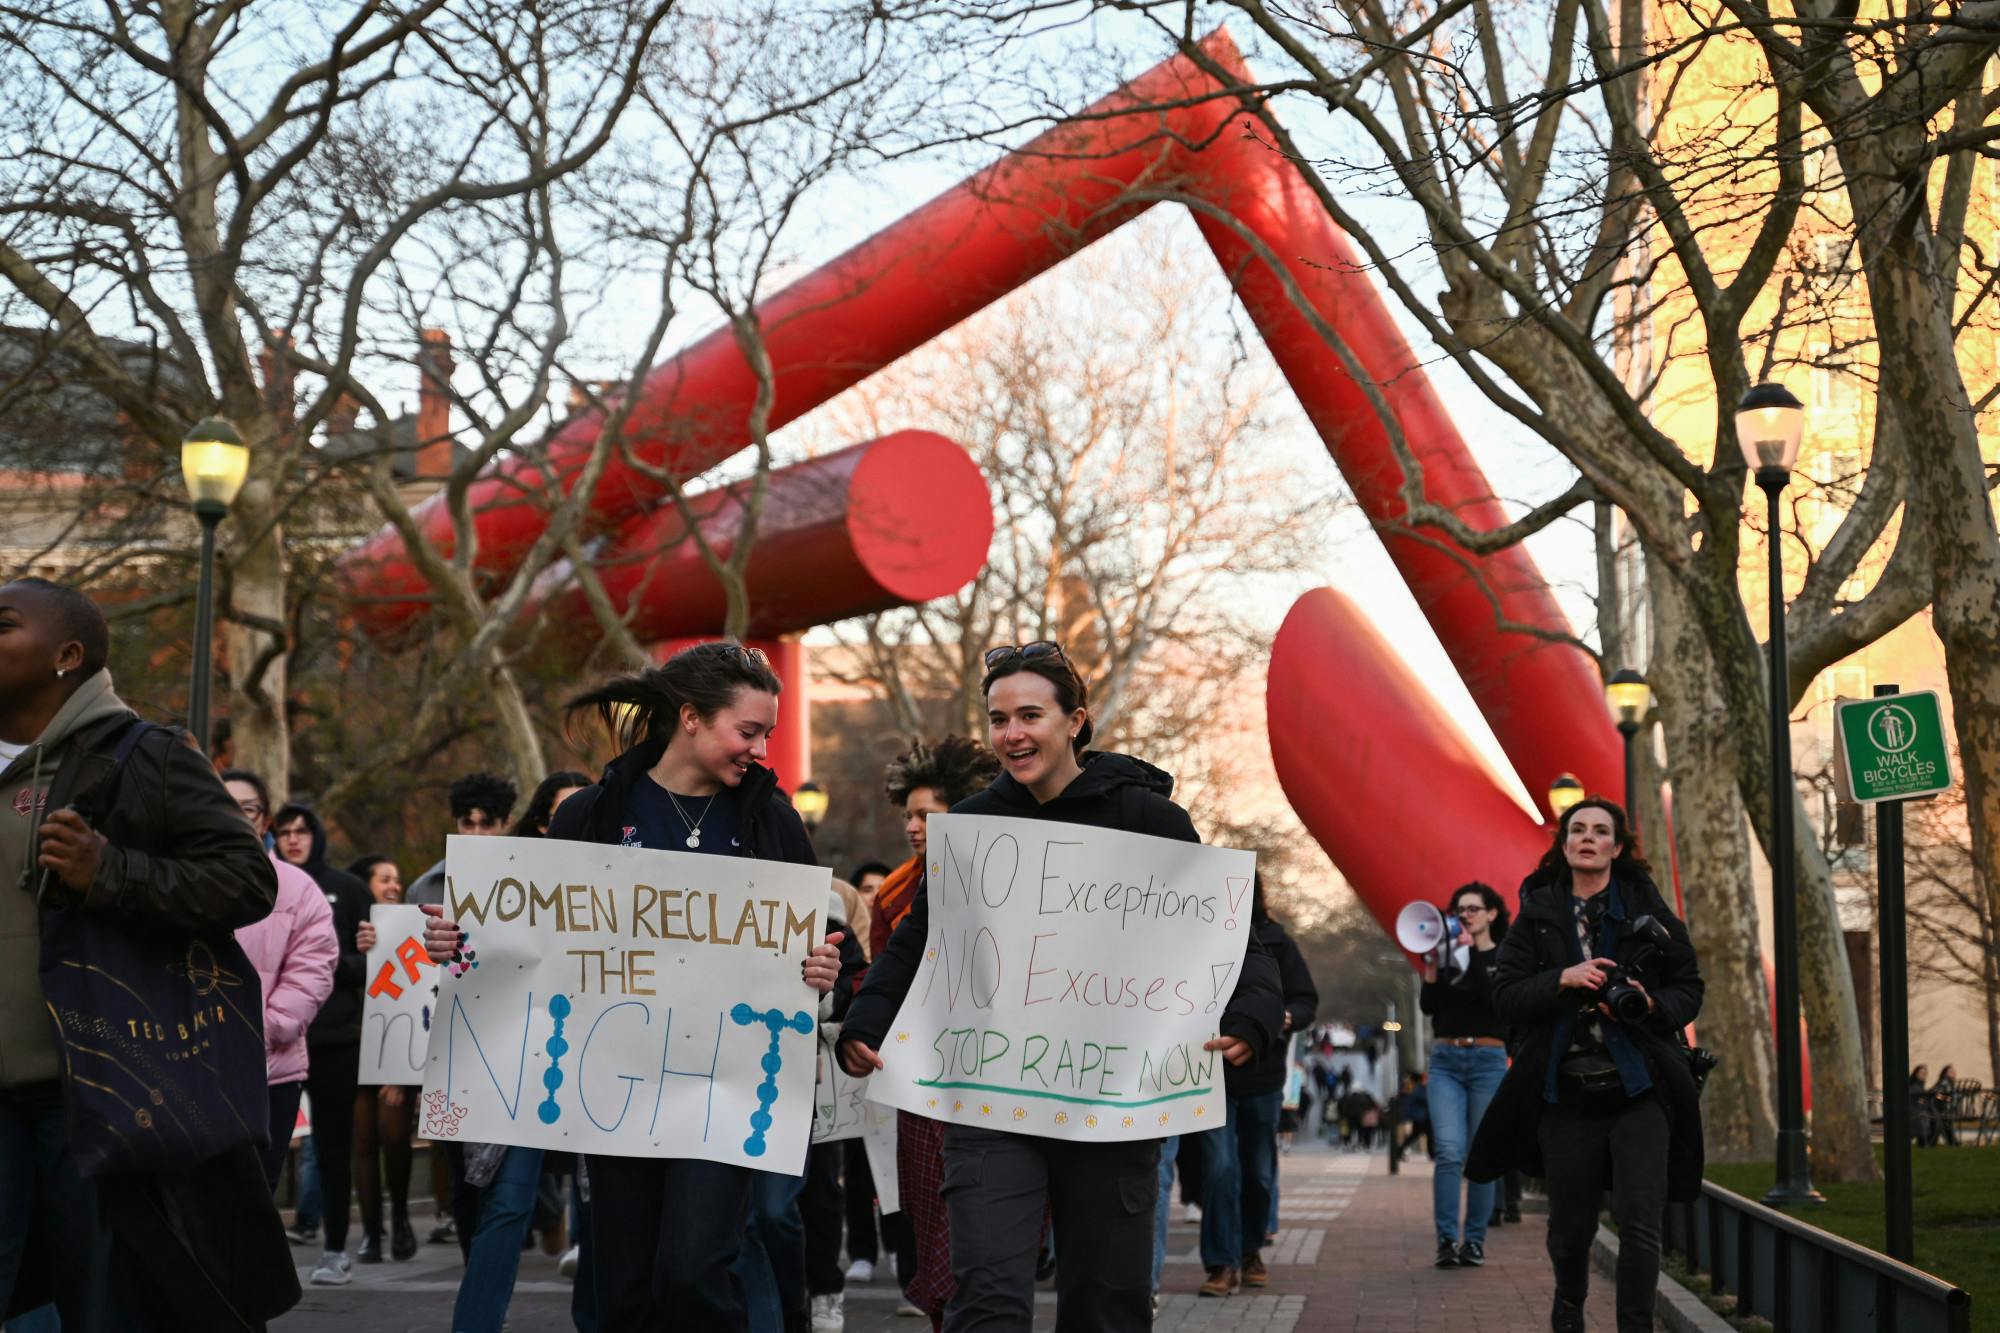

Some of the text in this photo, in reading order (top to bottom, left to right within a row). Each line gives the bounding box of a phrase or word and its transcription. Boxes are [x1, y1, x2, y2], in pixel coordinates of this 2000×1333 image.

[1864, 761, 1935, 782] BICYCLES
[1876, 751, 1918, 767] WALK
[942, 831, 1019, 909] NO
[447, 875, 817, 956] WOMEN RECLAIM
[566, 950, 657, 996] THE
[921, 926, 1001, 1014] NO
[128, 1020, 165, 1040] TED
[931, 1028, 1217, 1096] STOP RAPE NOW
[446, 991, 815, 1158] NIGHT
